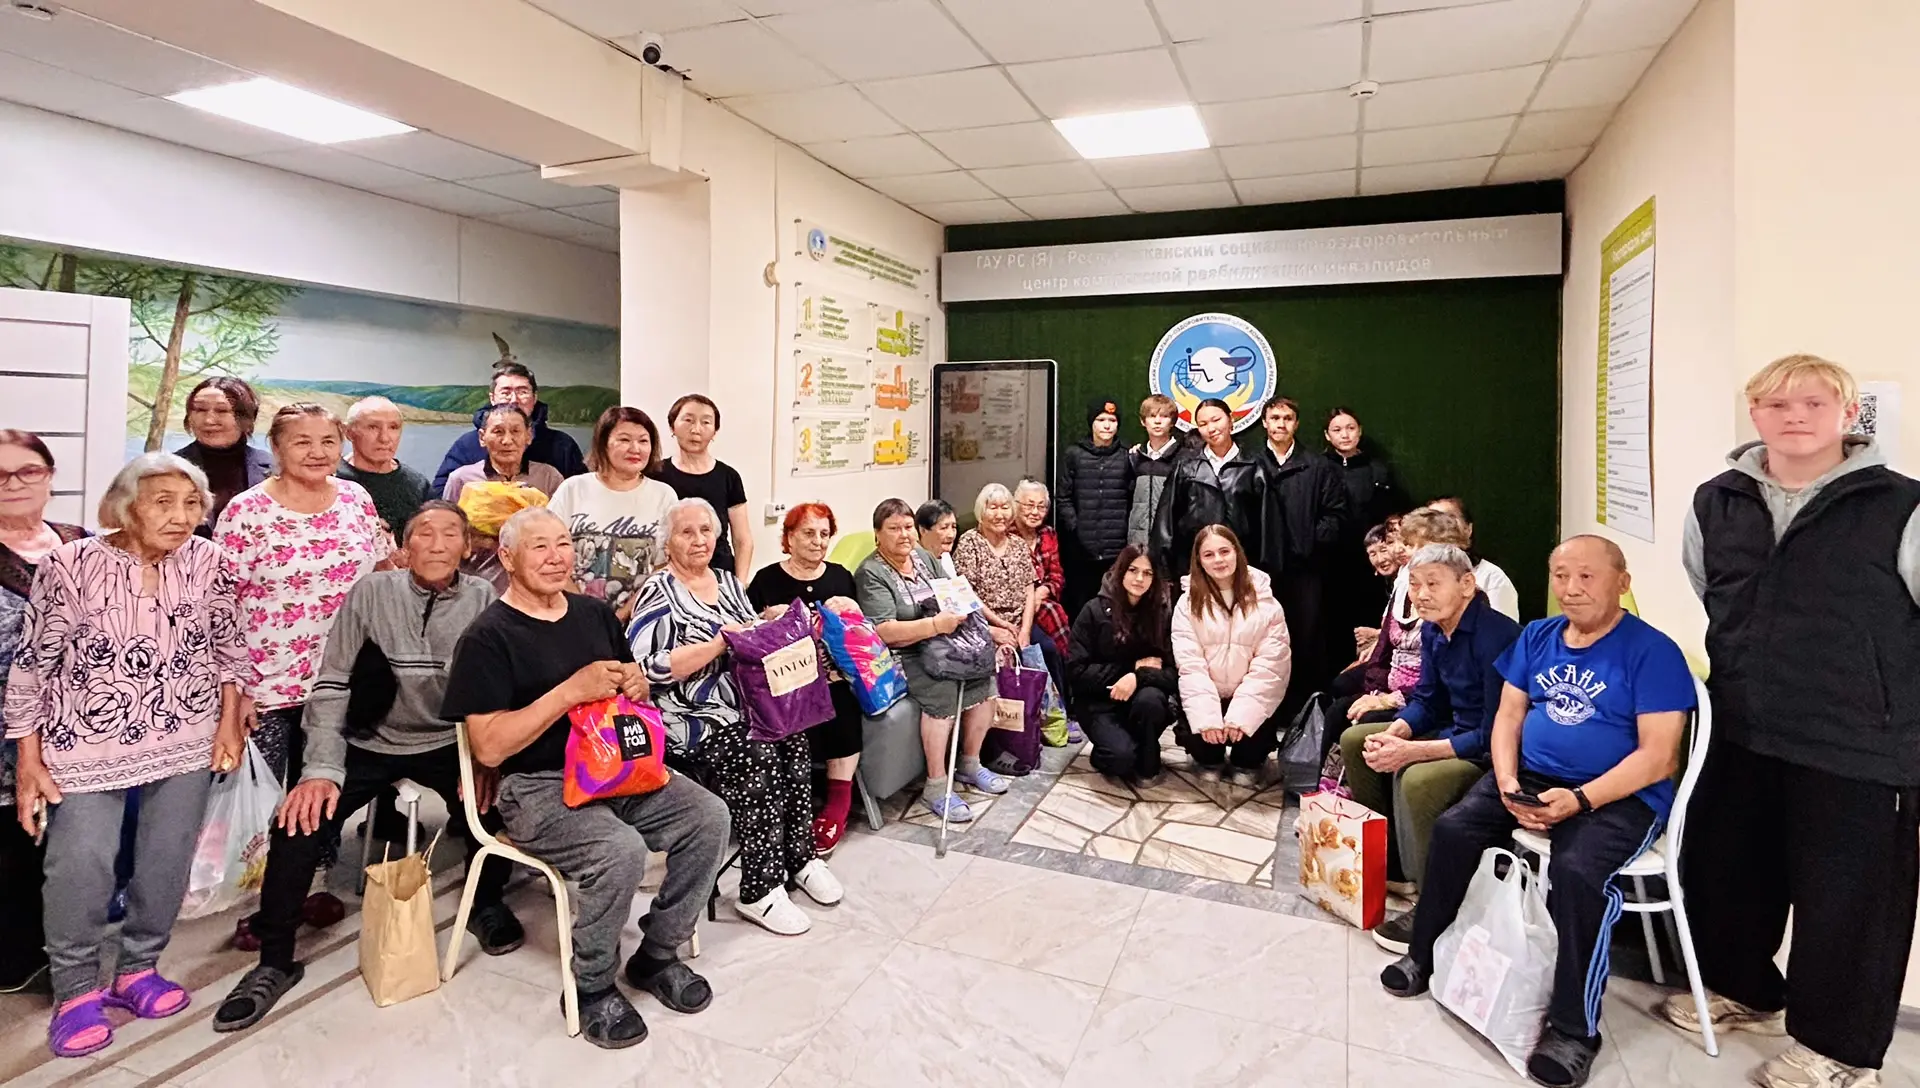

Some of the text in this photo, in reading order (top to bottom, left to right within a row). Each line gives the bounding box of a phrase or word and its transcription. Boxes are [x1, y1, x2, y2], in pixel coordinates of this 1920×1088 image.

[976, 252, 1001, 269] ГАУ
[1008, 252, 1025, 268] РС
[1031, 250, 1053, 270] (Я)
[1068, 245, 1213, 264] Респканский
[1023, 276, 1068, 291] центр
[1073, 267, 1182, 288] компксной
[800, 363, 812, 388] 2
[799, 428, 811, 454] 3
[569, 513, 660, 539] The Most
